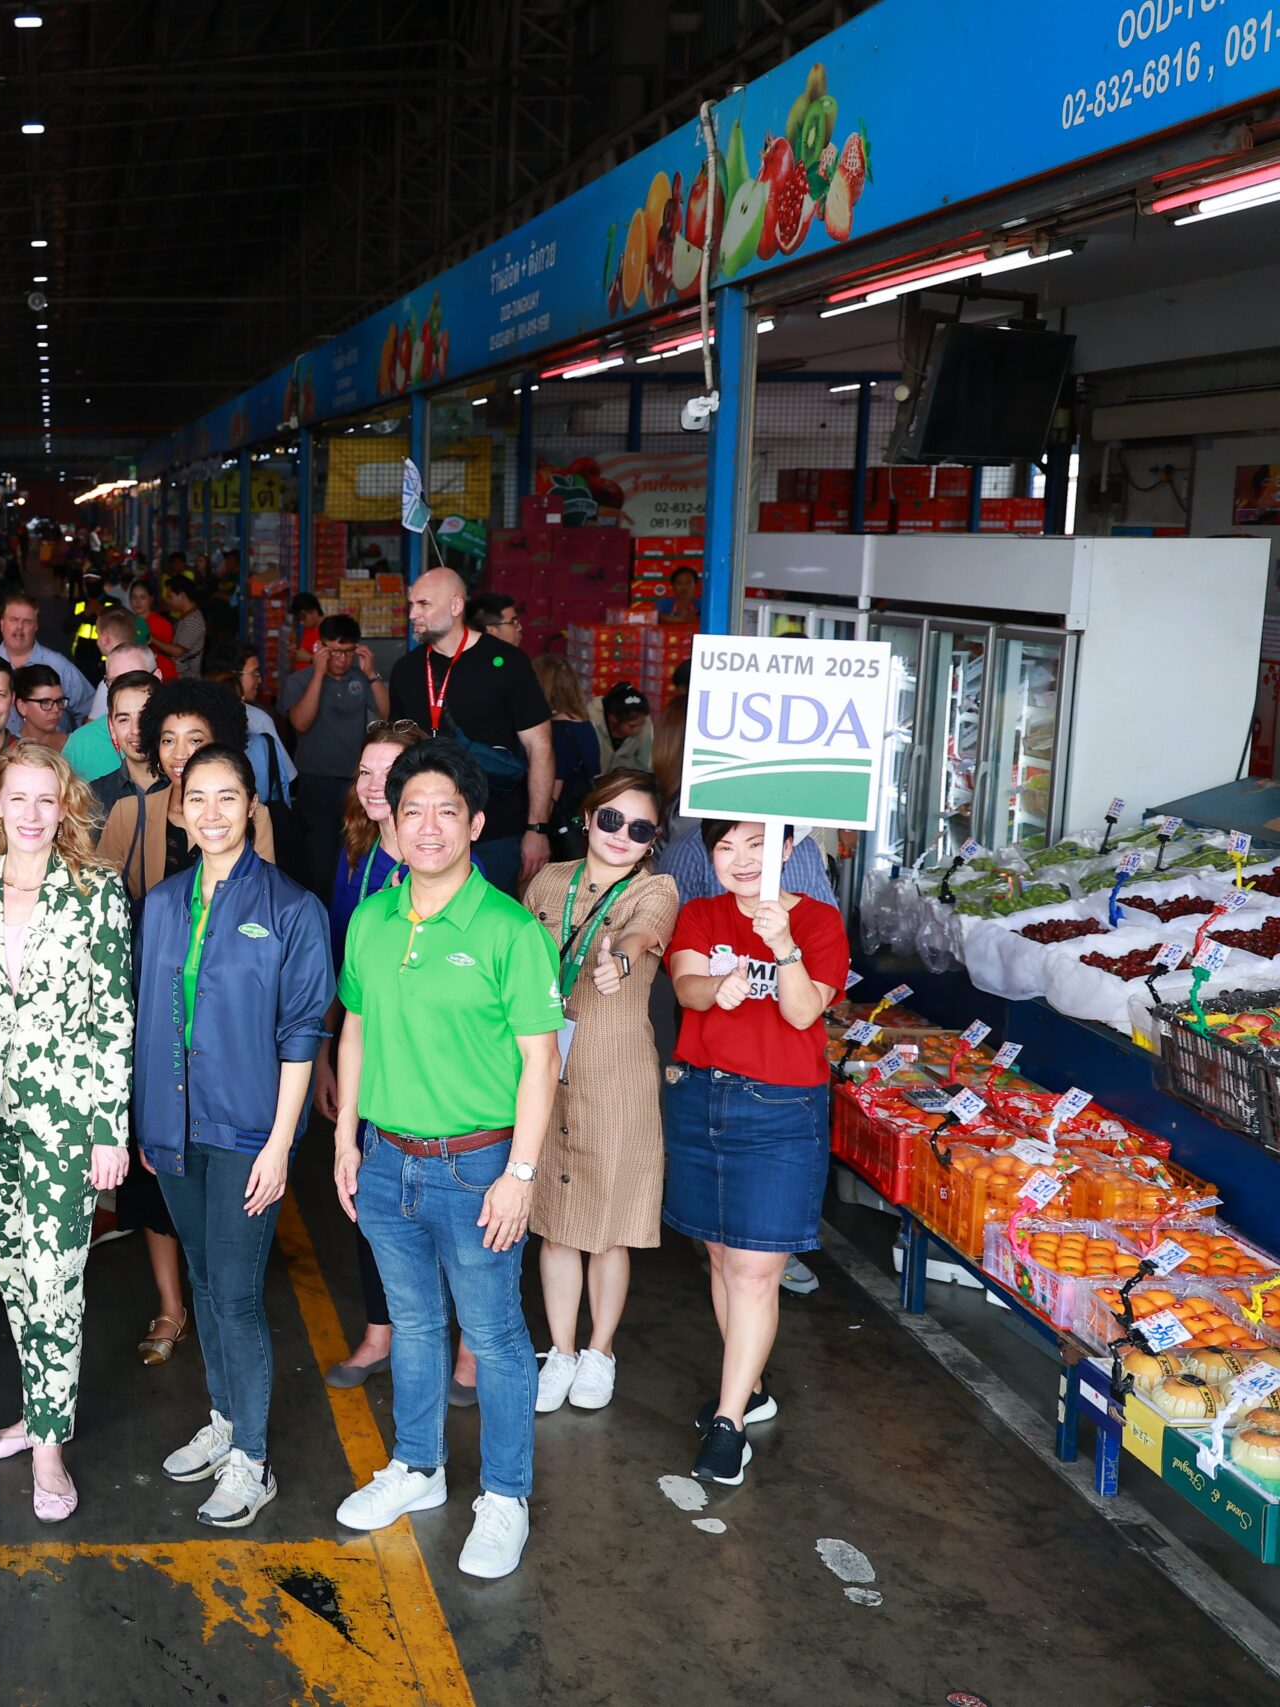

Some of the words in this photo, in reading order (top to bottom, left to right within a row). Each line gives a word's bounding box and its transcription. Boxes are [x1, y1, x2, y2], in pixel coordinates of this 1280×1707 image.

[1062, 41, 1201, 130] 02-832-6816
[650, 518, 687, 529] 081-91
[700, 651, 760, 673] USDA
[766, 654, 814, 675] ATM
[825, 657, 880, 679] 2025
[697, 690, 872, 749] USDA
[172, 977, 180, 1024] TALAAD
[1033, 1180, 1056, 1198] 210
[1151, 1323, 1176, 1347] 350
[1211, 1489, 1220, 1502] &
[1226, 1500, 1252, 1529] Sweet
